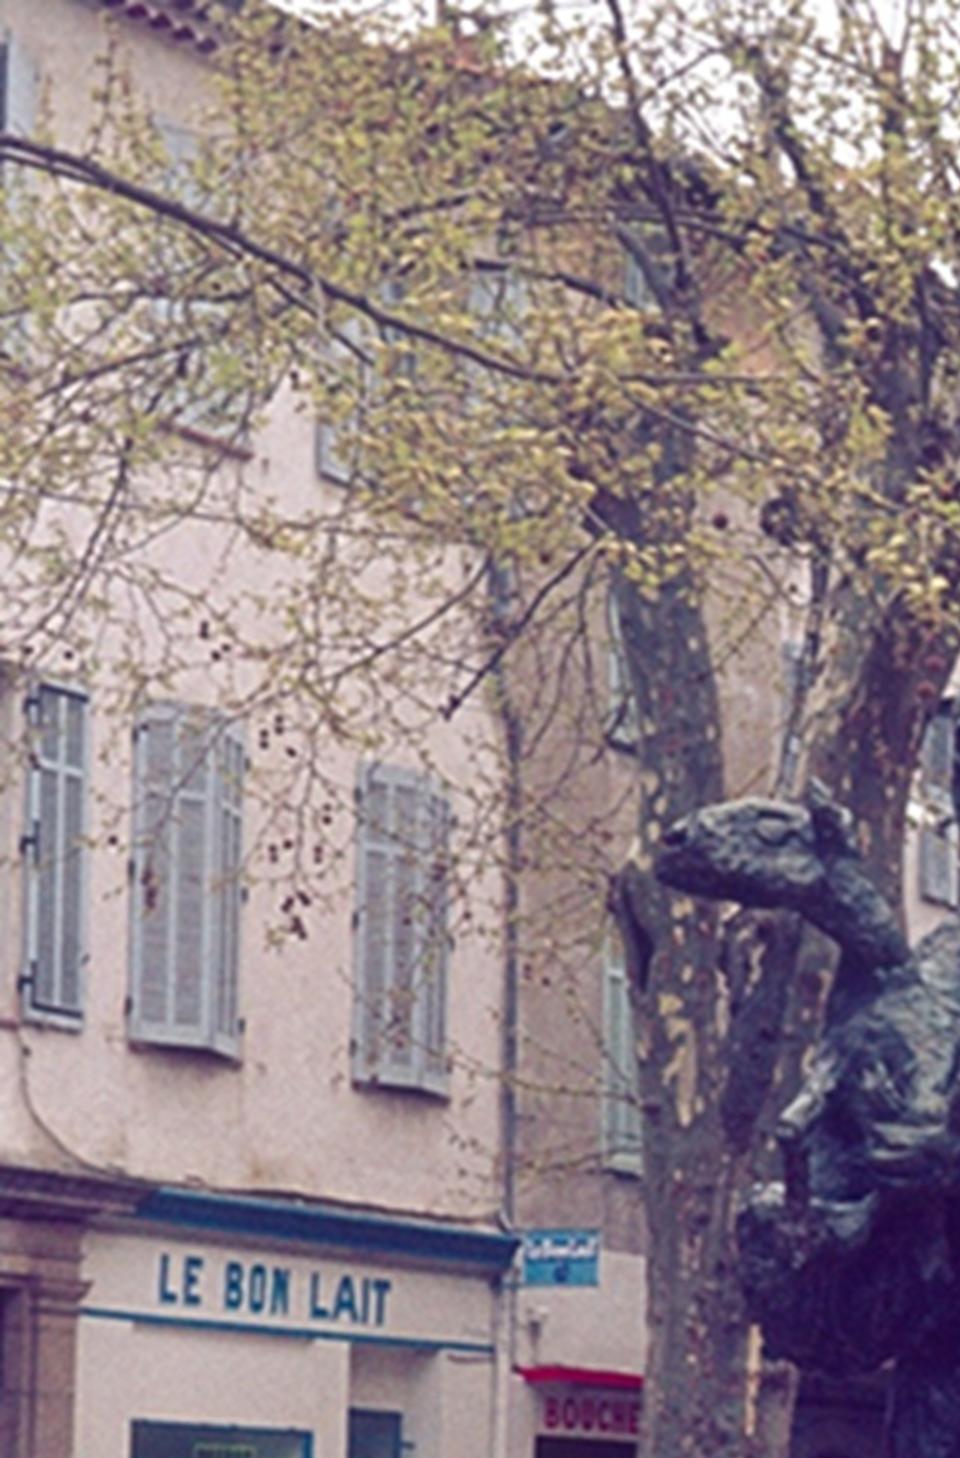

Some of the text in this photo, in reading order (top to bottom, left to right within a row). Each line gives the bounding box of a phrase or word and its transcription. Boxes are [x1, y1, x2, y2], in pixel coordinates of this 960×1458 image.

[159, 1252, 391, 1327] LE BON LAIT
[544, 1396, 641, 1436] BOUCHE
